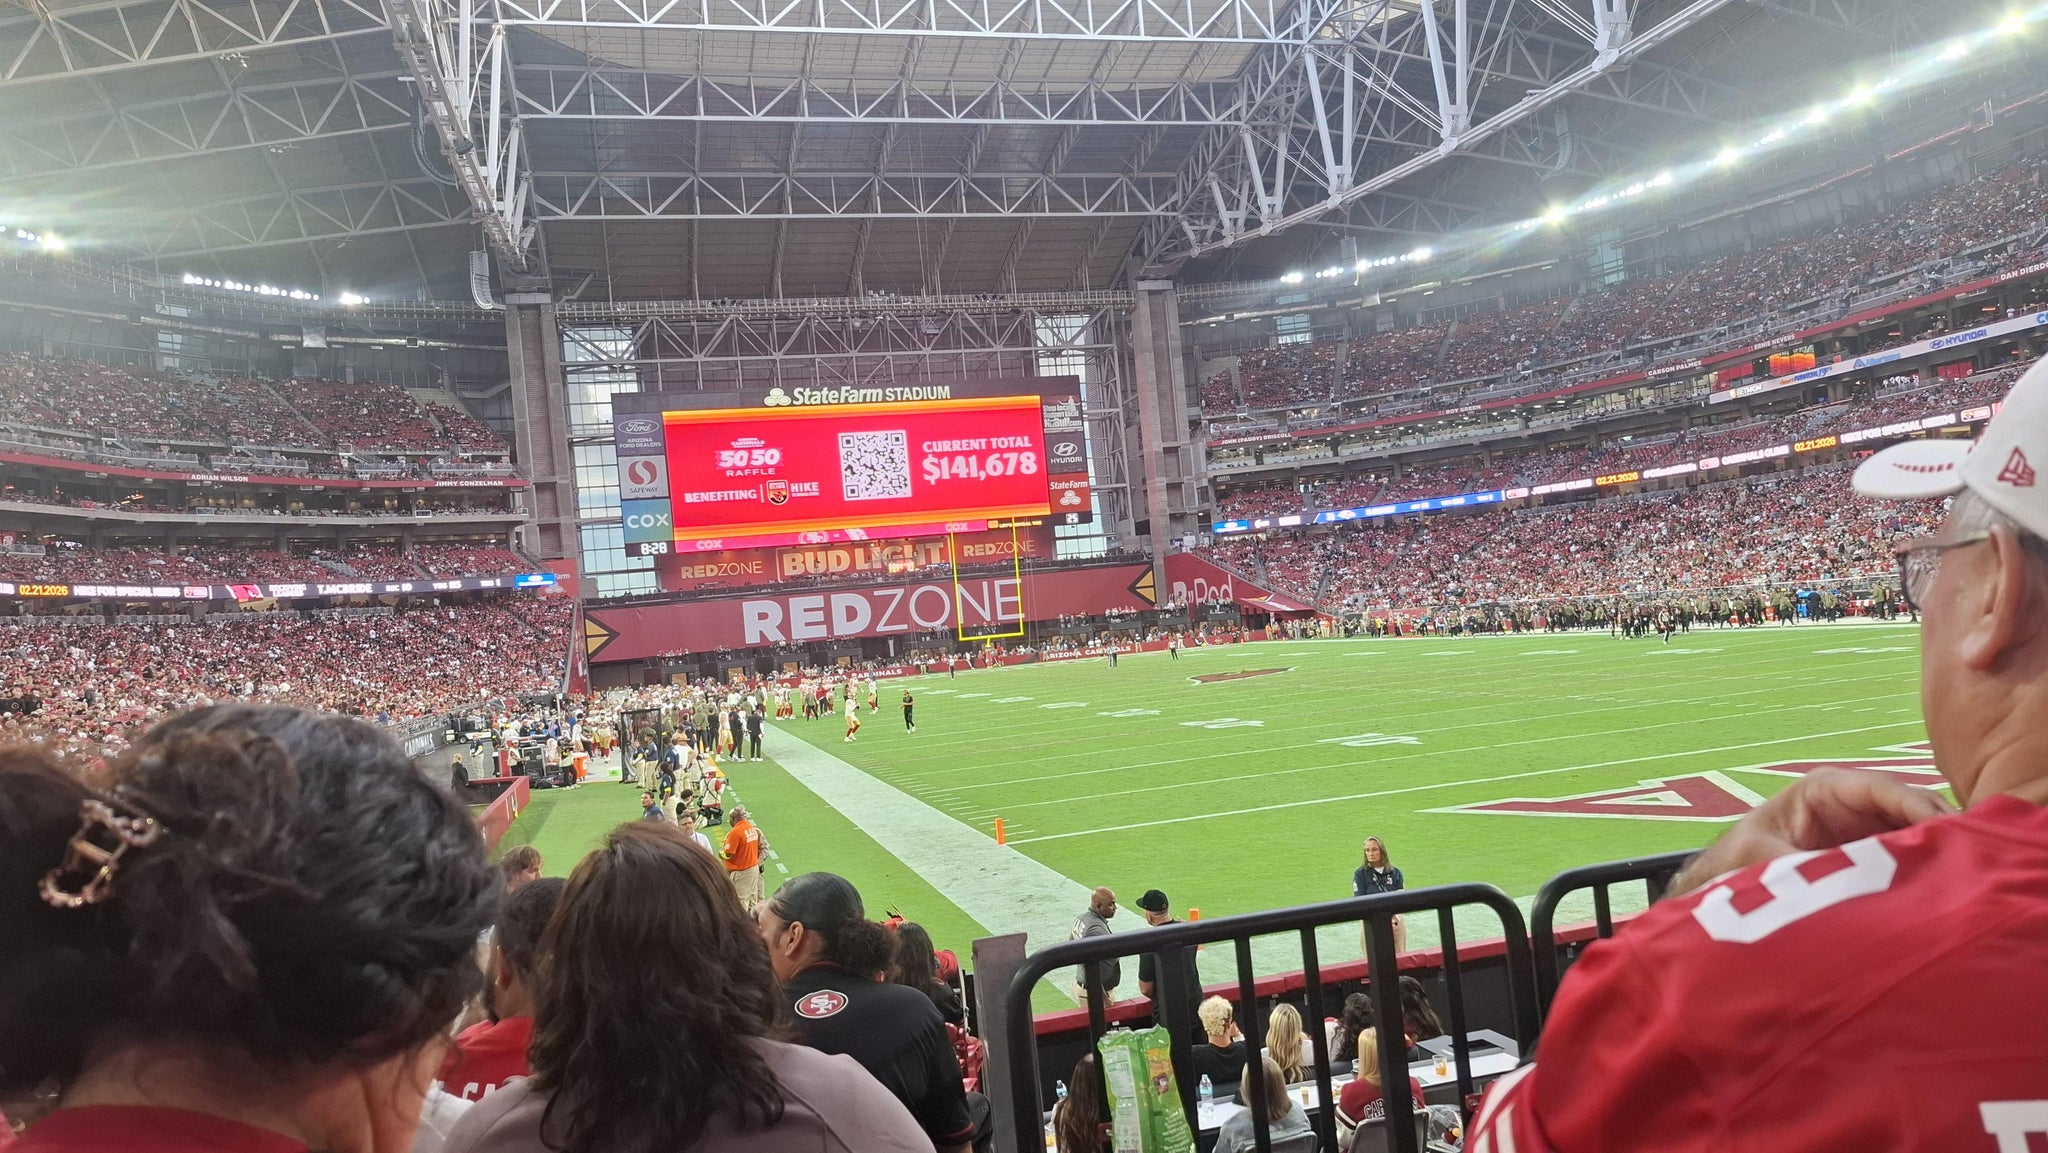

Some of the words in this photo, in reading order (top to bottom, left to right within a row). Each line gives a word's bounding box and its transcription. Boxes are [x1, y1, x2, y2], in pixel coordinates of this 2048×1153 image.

[2000, 270, 2018, 281] DAN
[1945, 329, 1987, 346] HYUNDAI
[1648, 366, 1675, 376] CARSON
[886, 386, 950, 402] STADIUM
[625, 421, 651, 432] Ford
[922, 438, 987, 452] CURRENT
[991, 436, 1032, 449] TOTAL
[1794, 436, 1837, 453] 02.21.2026
[719, 451, 748, 467] 50
[750, 448, 781, 466] 50
[1051, 456, 1082, 464] HYUNDAI
[726, 468, 775, 477] RAFFLE
[922, 451, 1037, 485] $141,678
[1596, 472, 1640, 485] 02.21.2026
[630, 486, 658, 494] SAFEWAY
[790, 482, 819, 492] HIKE
[684, 489, 757, 503] BENEFITING
[627, 513, 669, 529] COX
[641, 542, 667, 554] 8:28
[696, 540, 721, 550] COX
[783, 549, 850, 576] BUD
[855, 542, 944, 571] LIGHT
[19, 584, 68, 597] 02.21.2026
